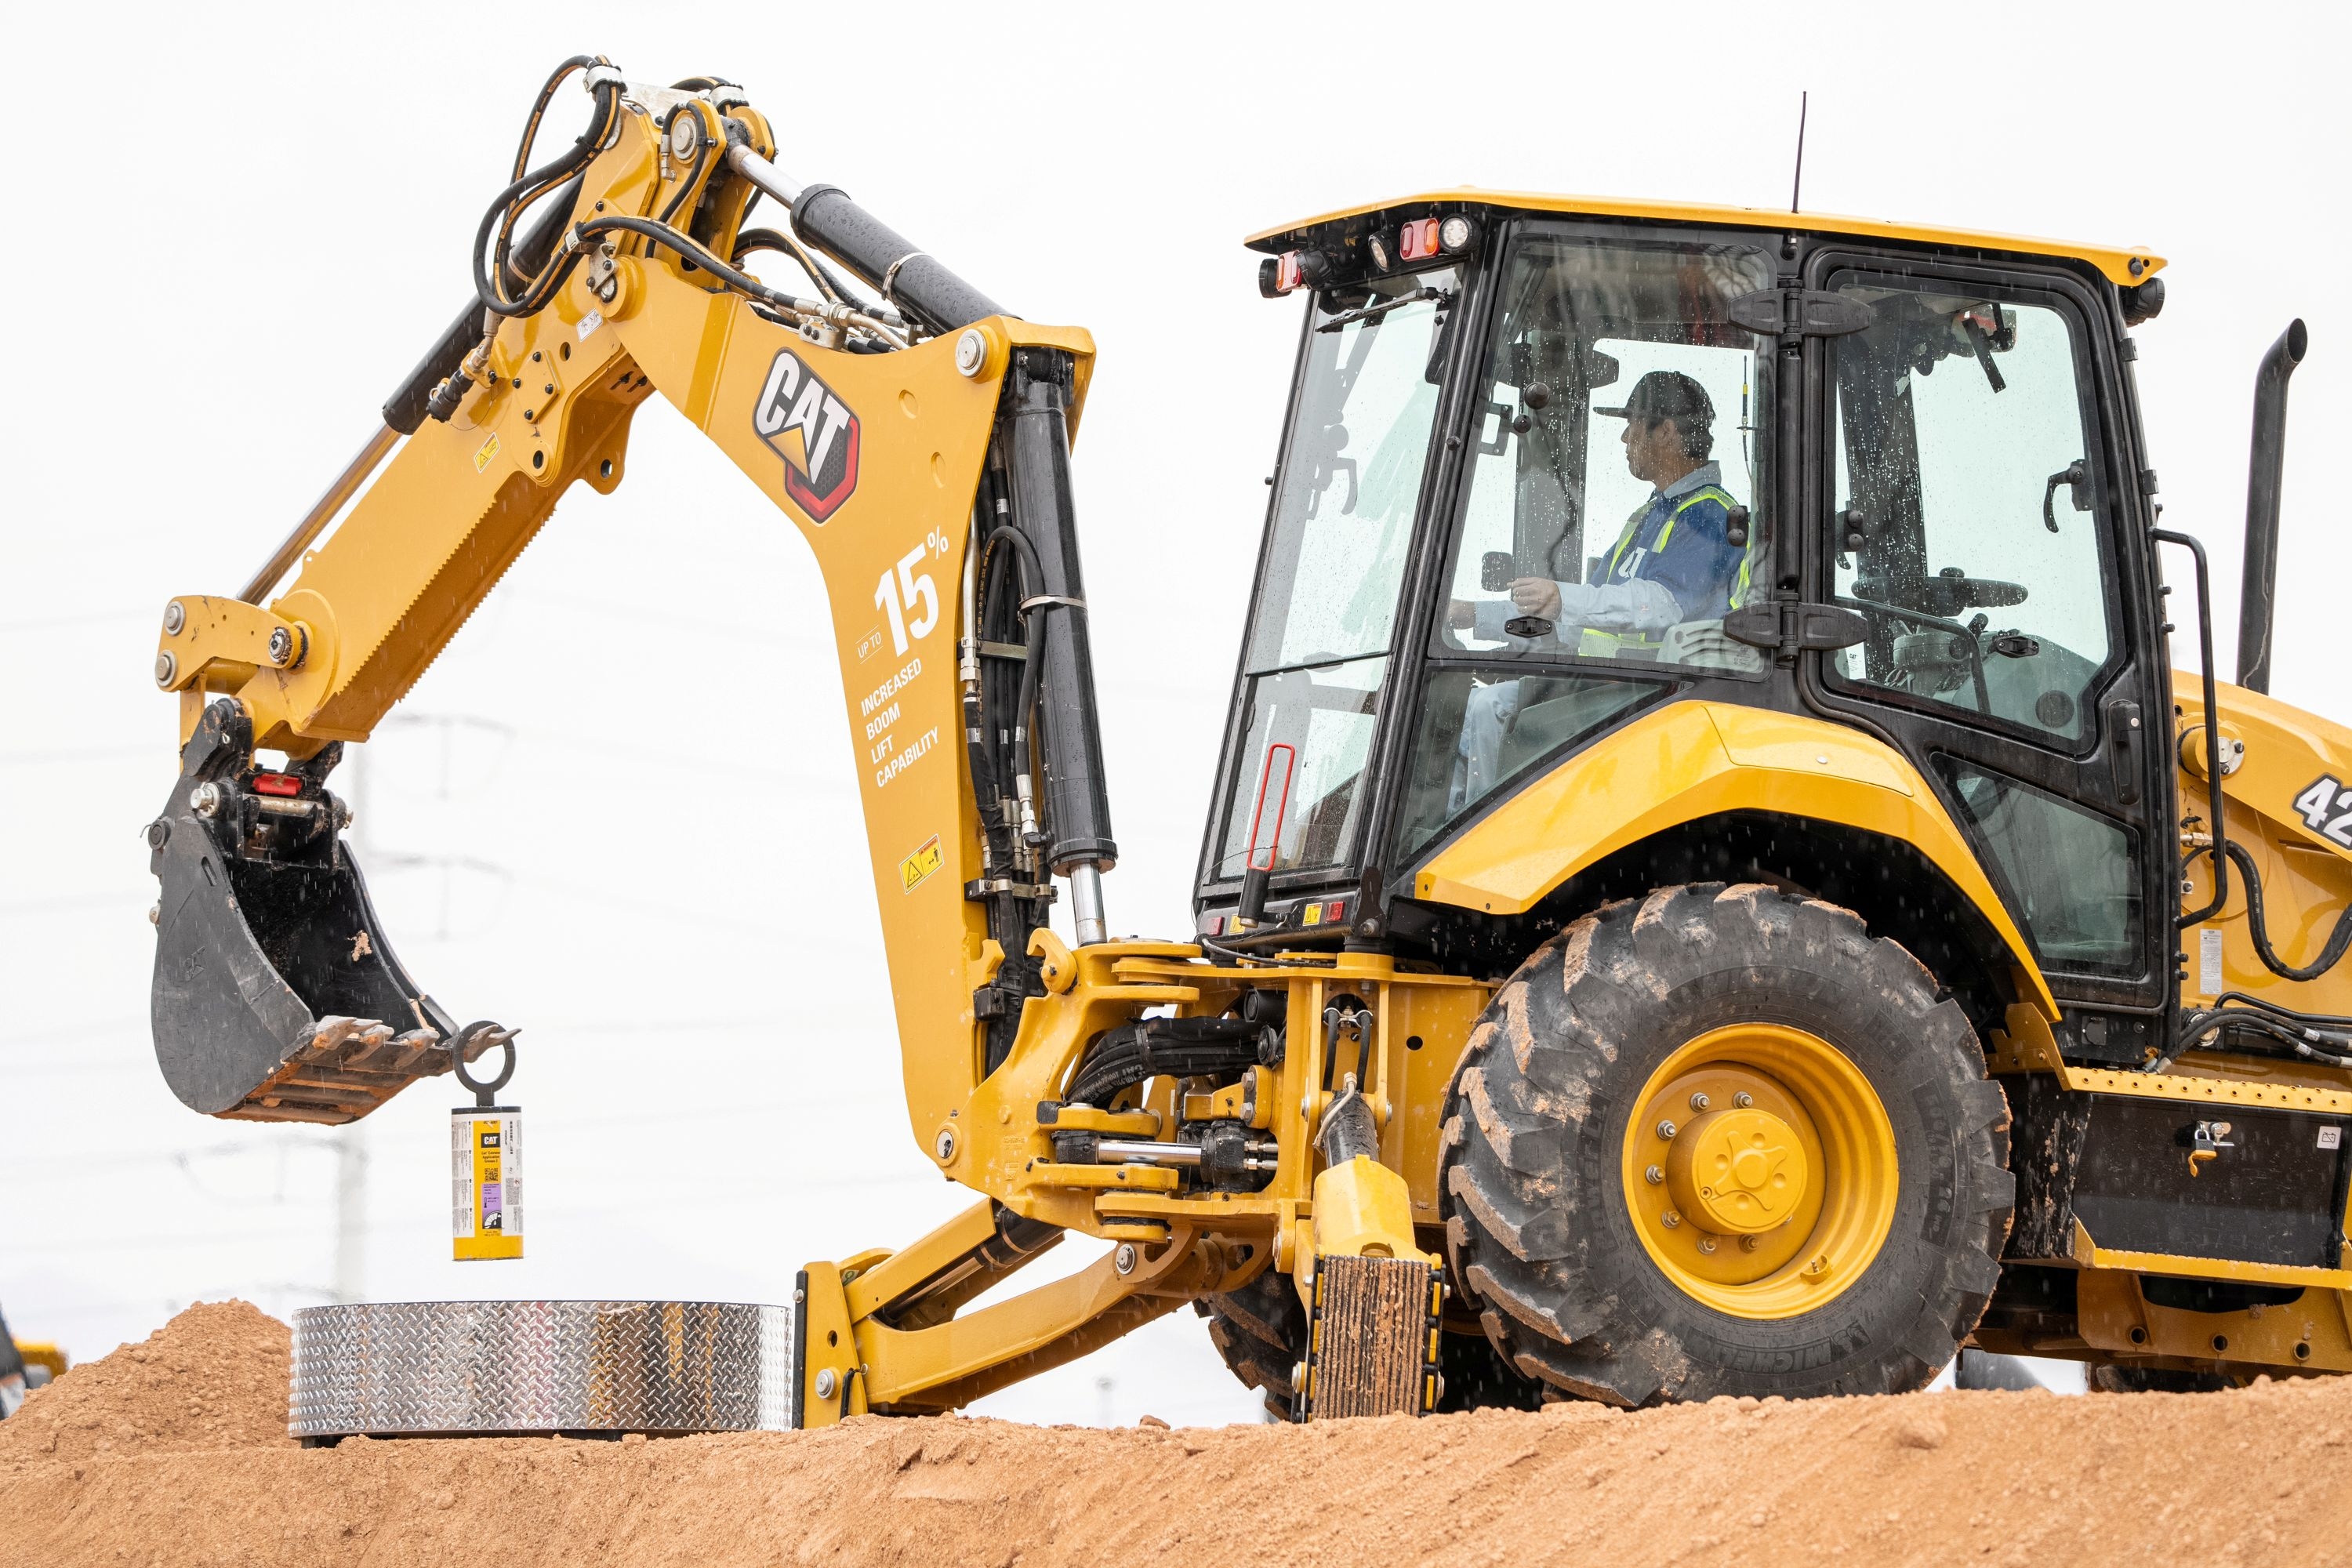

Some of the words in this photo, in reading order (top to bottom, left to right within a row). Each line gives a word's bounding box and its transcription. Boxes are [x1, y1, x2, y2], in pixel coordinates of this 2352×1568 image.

[756, 352, 851, 485] CAT
[857, 641, 869, 659] UP
[869, 631, 882, 646] TO
[861, 658, 922, 717] INCREASED
[866, 702, 901, 741] BOOM
[870, 734, 893, 765] LIFT
[876, 725, 939, 788] CAPABILITY
[484, 1136, 498, 1145] CAT
